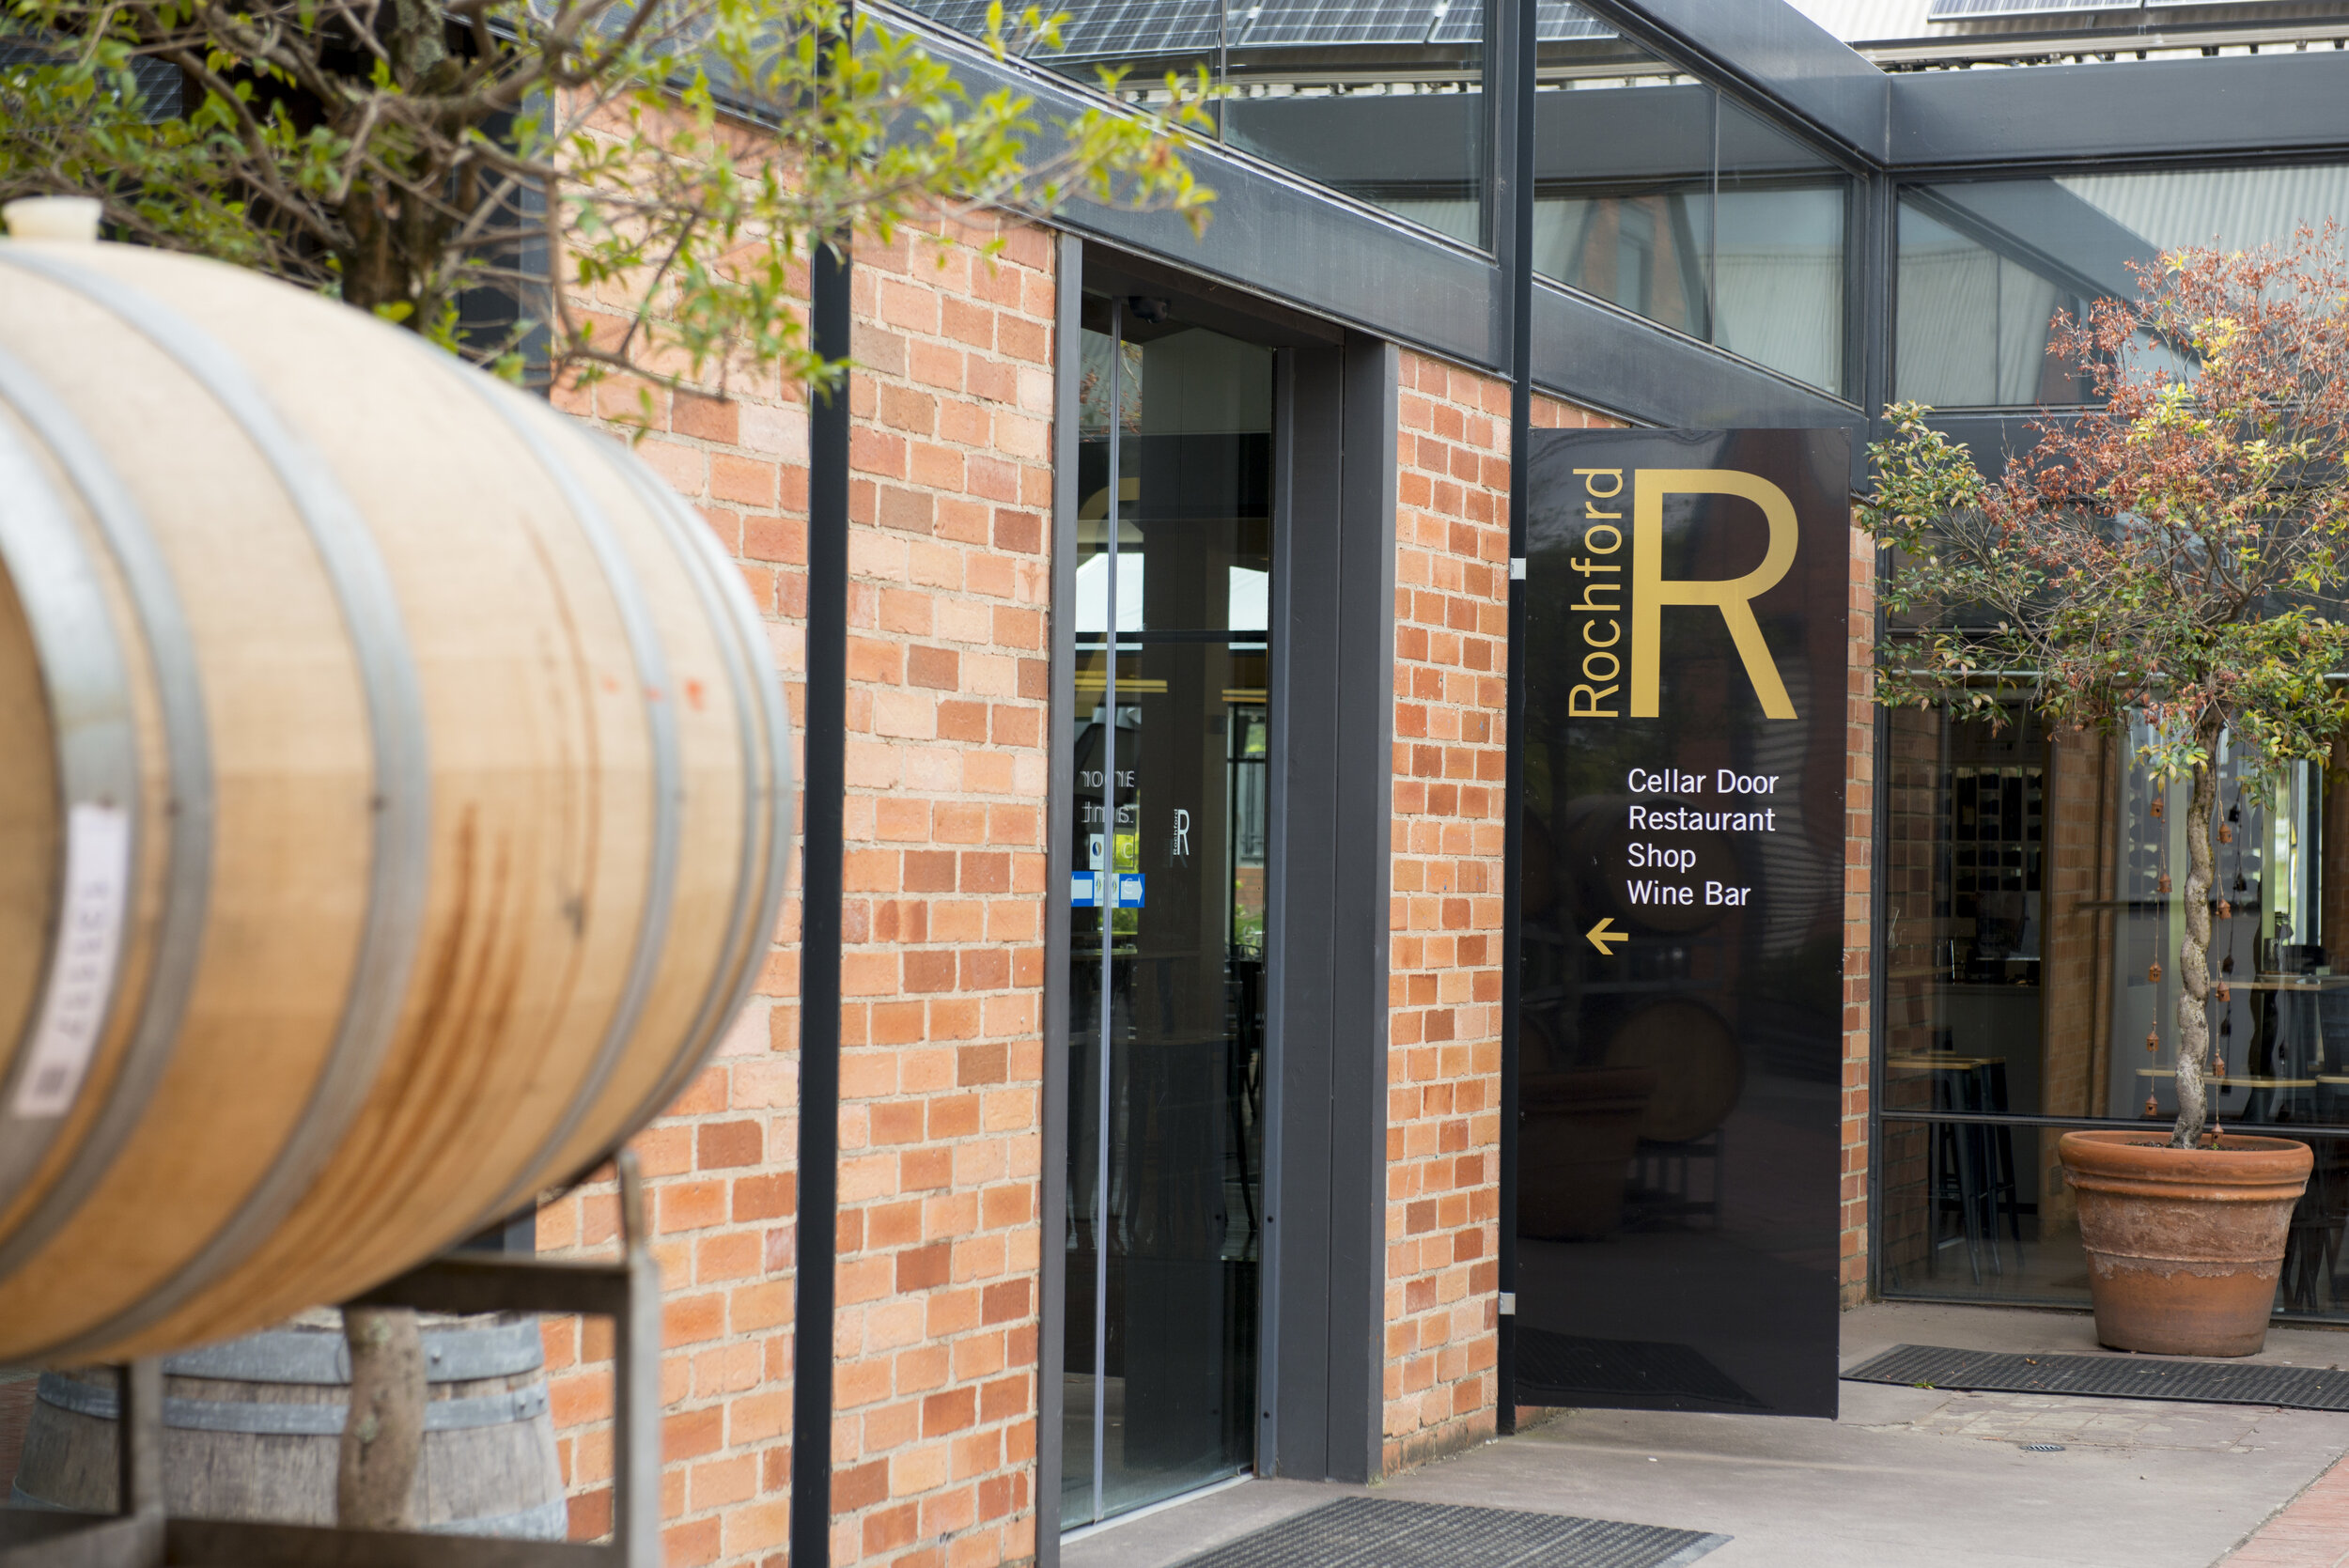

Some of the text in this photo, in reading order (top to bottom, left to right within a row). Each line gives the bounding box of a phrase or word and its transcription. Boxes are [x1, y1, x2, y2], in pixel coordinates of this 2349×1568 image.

[1568, 468, 1624, 719] Rochford
[1629, 468, 1799, 721] R
[1627, 768, 1780, 795] Cellar Door
[1177, 809, 1190, 856] R
[1628, 805, 1776, 831] Restaurant
[1626, 842, 1697, 874] Shop
[1626, 879, 1751, 907] Wine Bar
